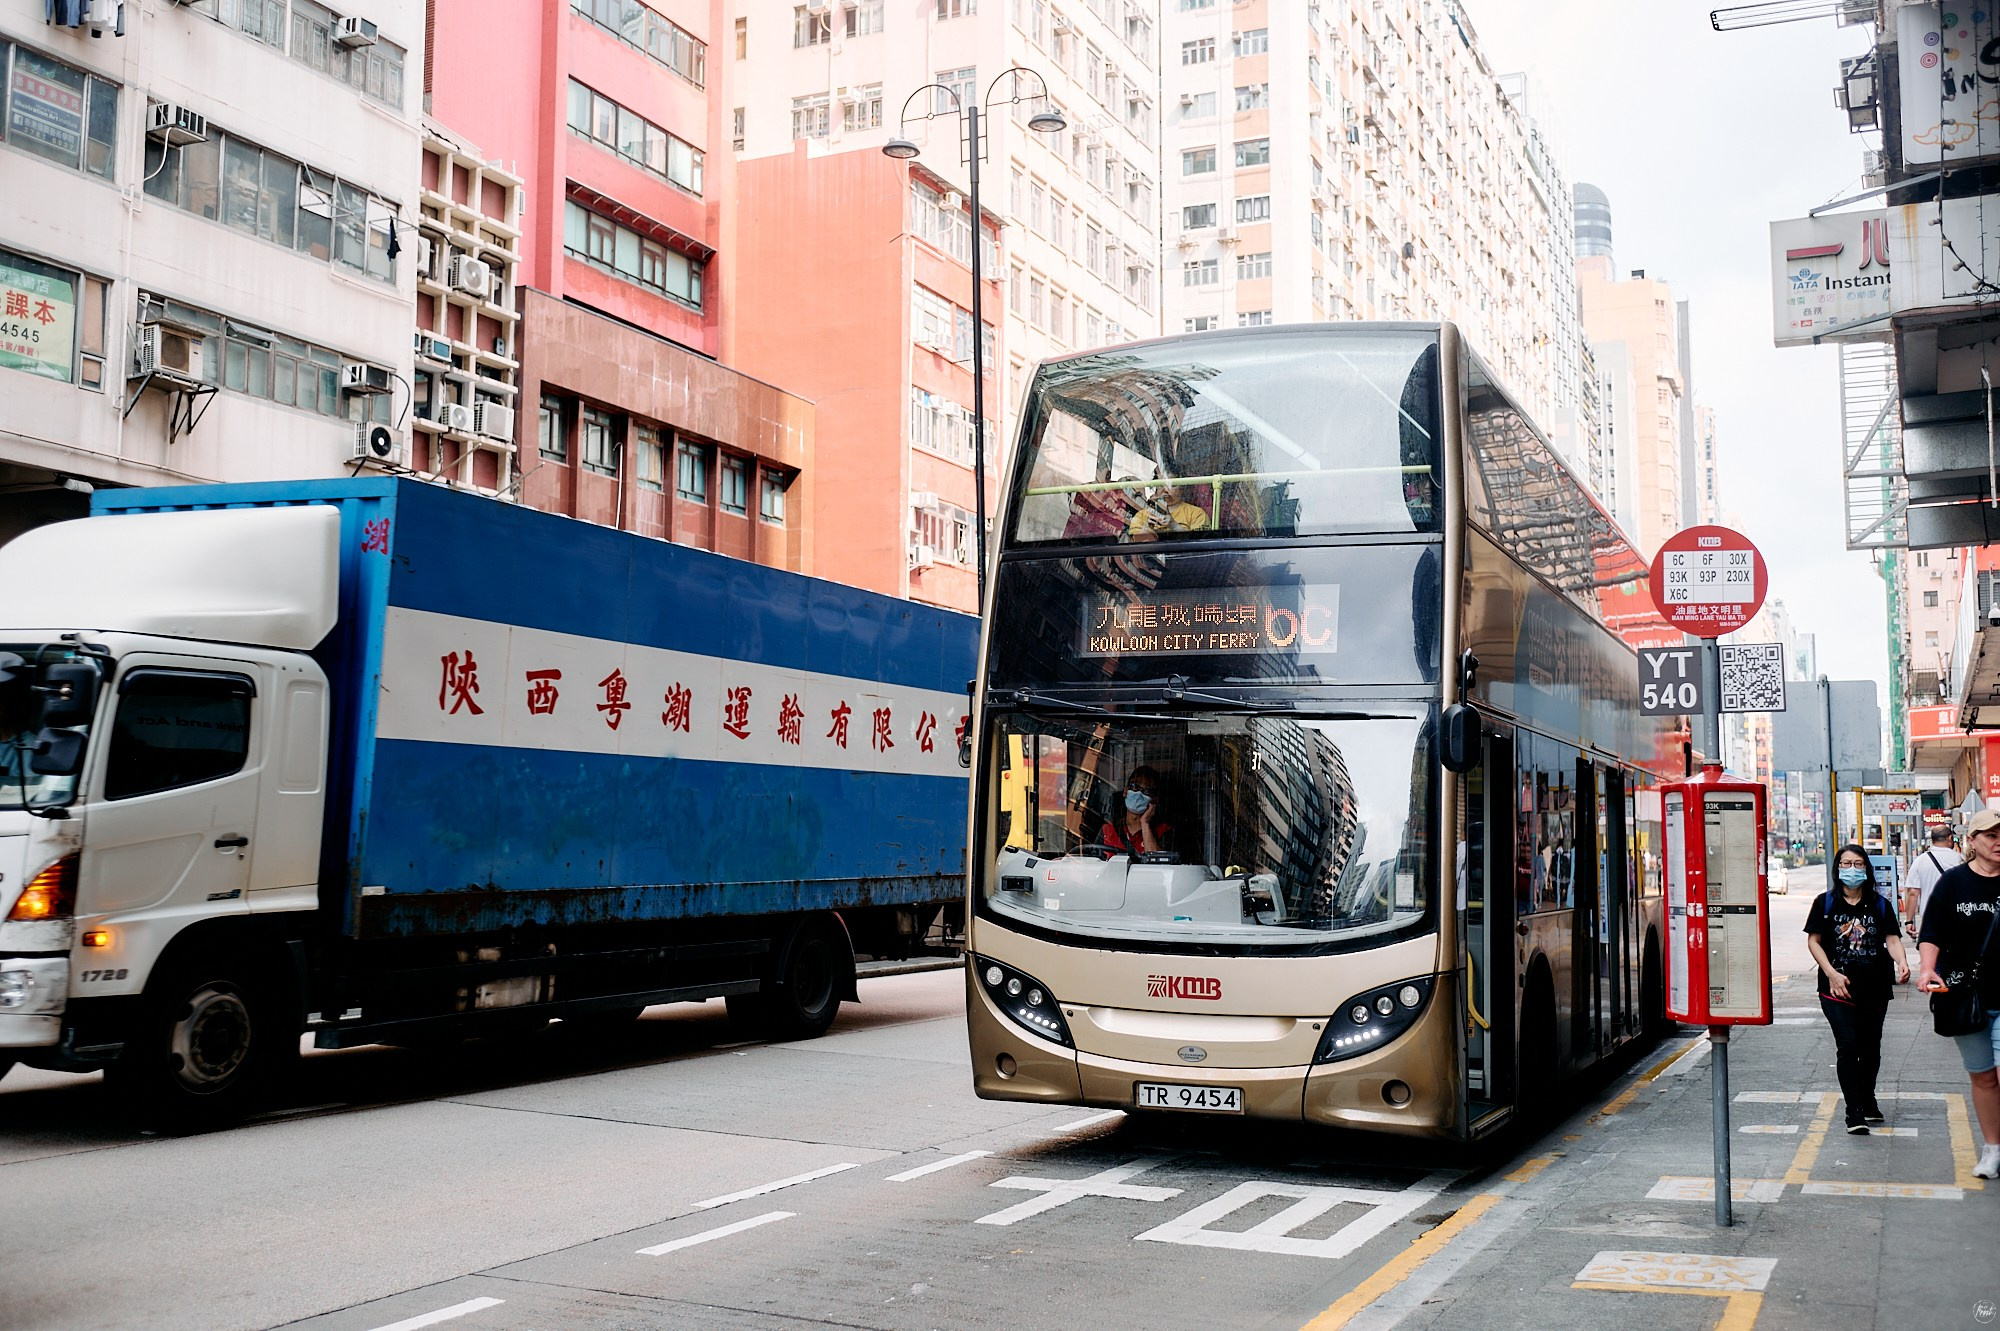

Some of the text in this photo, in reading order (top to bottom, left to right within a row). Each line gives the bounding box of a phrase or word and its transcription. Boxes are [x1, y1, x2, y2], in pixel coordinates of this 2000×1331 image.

[1793, 281, 1819, 291] IATA
[1825, 272, 1891, 290] Instant
[0, 290, 55, 326] 課本
[1697, 536, 1722, 548] KMB
[1672, 553, 1747, 566] 6C 6F 30X
[1669, 570, 1750, 583] 93K 93P 230X
[1669, 588, 1688, 600] X6C
[1675, 605, 1743, 616] 油麻地文明里
[1090, 633, 1260, 652] KOWLOON CITY FERRY
[1643, 651, 1694, 679] YT
[1643, 682, 1698, 710] 540
[1704, 802, 1719, 810] 93K
[1708, 906, 1722, 914] 93P
[81, 968, 129, 983] 1728
[1167, 975, 1222, 1001] KMB
[1143, 1086, 1237, 1108] TR 9454
[1587, 1265, 1758, 1286] 230X
